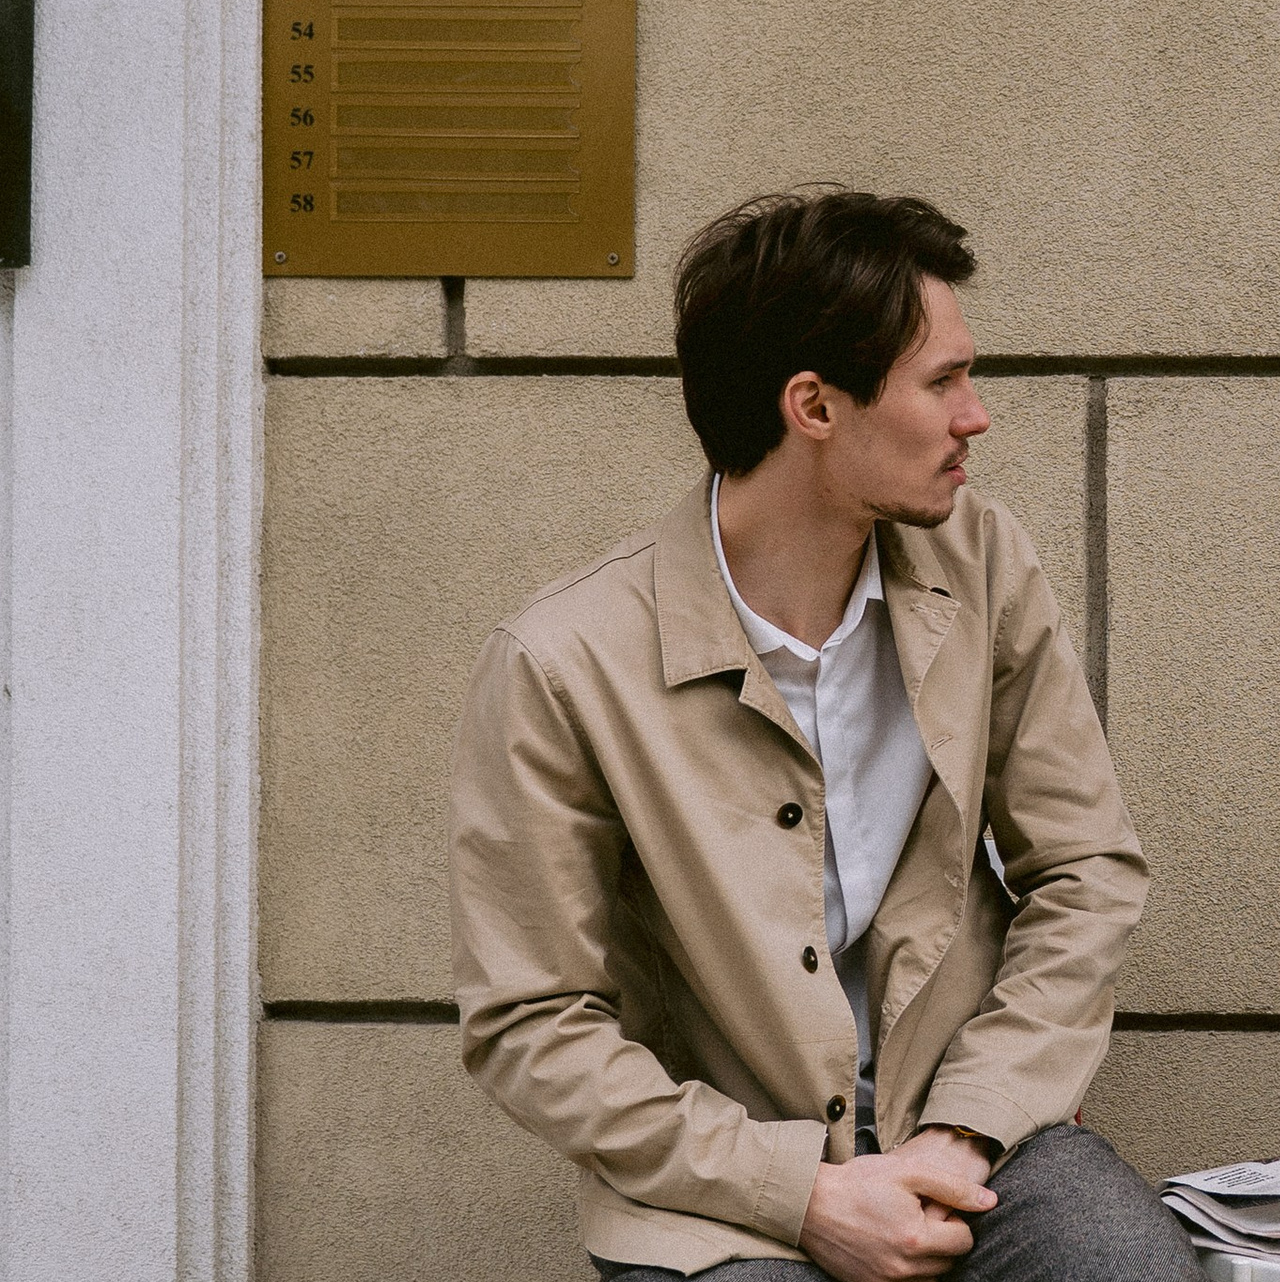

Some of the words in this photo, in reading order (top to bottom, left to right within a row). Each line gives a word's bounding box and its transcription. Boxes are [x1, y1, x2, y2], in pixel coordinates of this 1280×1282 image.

[290, 22, 316, 42] 54
[289, 65, 316, 85] 55
[289, 108, 316, 128] 56
[289, 151, 316, 171] 57
[289, 194, 316, 214] 58
